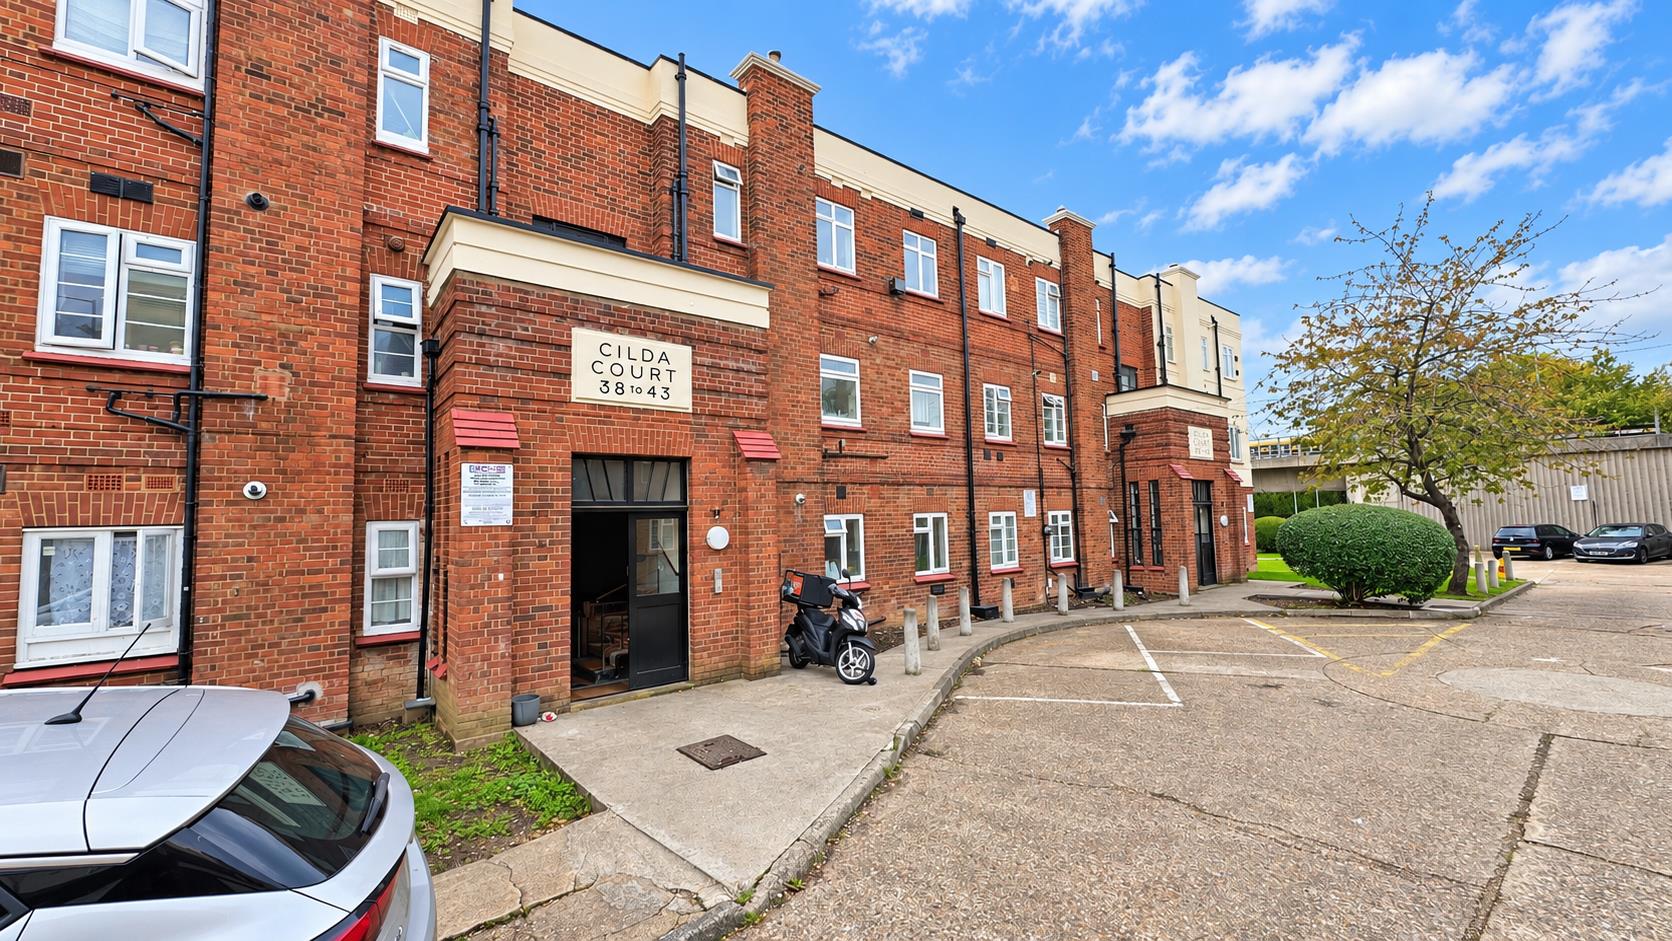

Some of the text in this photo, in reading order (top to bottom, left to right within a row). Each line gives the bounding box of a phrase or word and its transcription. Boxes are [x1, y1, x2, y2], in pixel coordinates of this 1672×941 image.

[599, 342, 671, 366] CILDA
[591, 360, 677, 383] COURT
[599, 379, 625, 396] 38
[647, 386, 670, 400] 43
